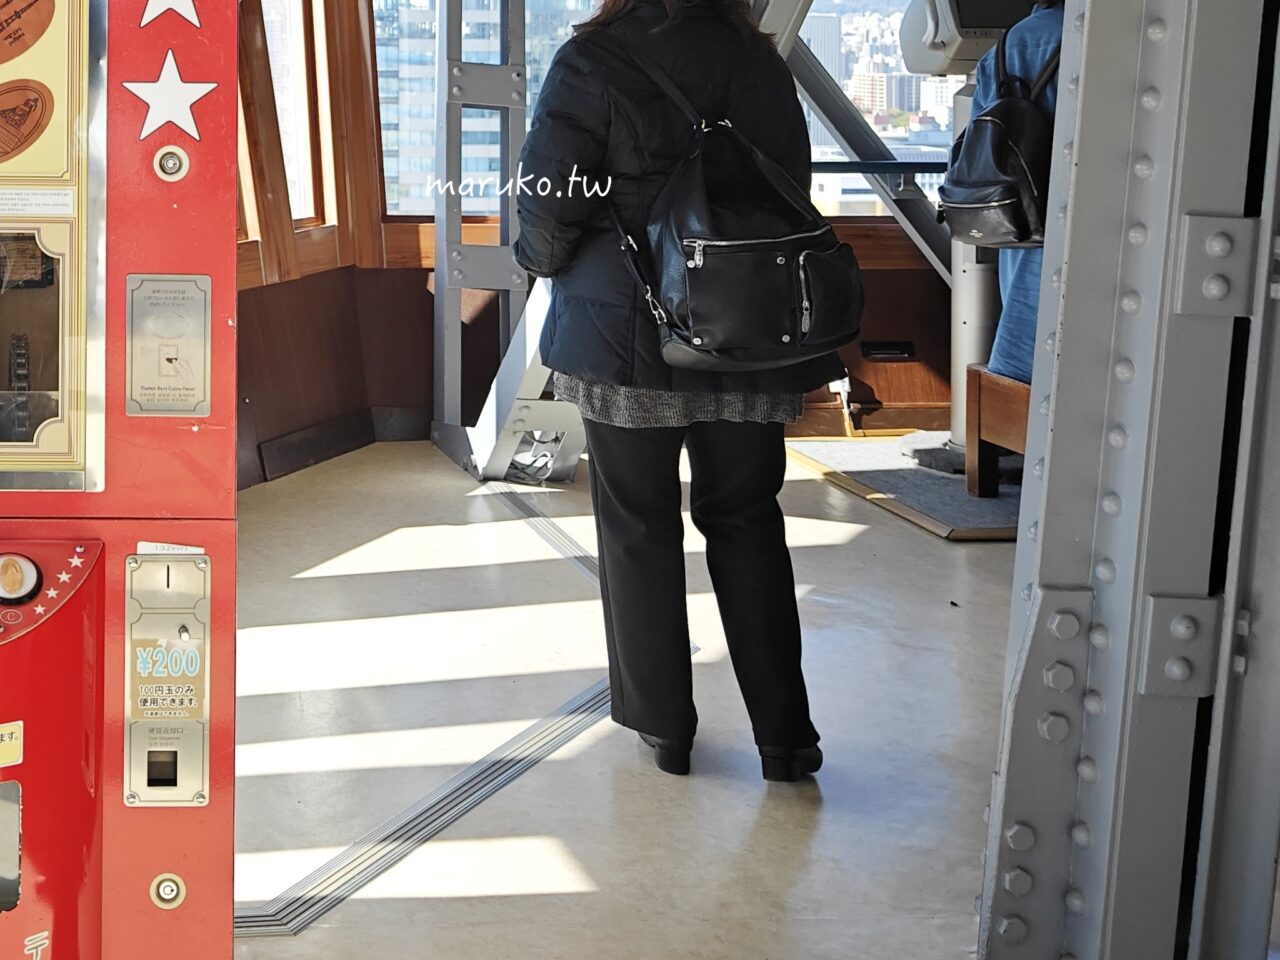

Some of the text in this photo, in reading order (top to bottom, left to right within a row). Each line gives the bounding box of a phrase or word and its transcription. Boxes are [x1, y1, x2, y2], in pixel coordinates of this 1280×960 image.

[6, 611, 16, 621] C
[136, 647, 200, 677] ¥200
[140, 685, 194, 695] 100円玉のみ
[139, 697, 198, 707] 使用できます。
